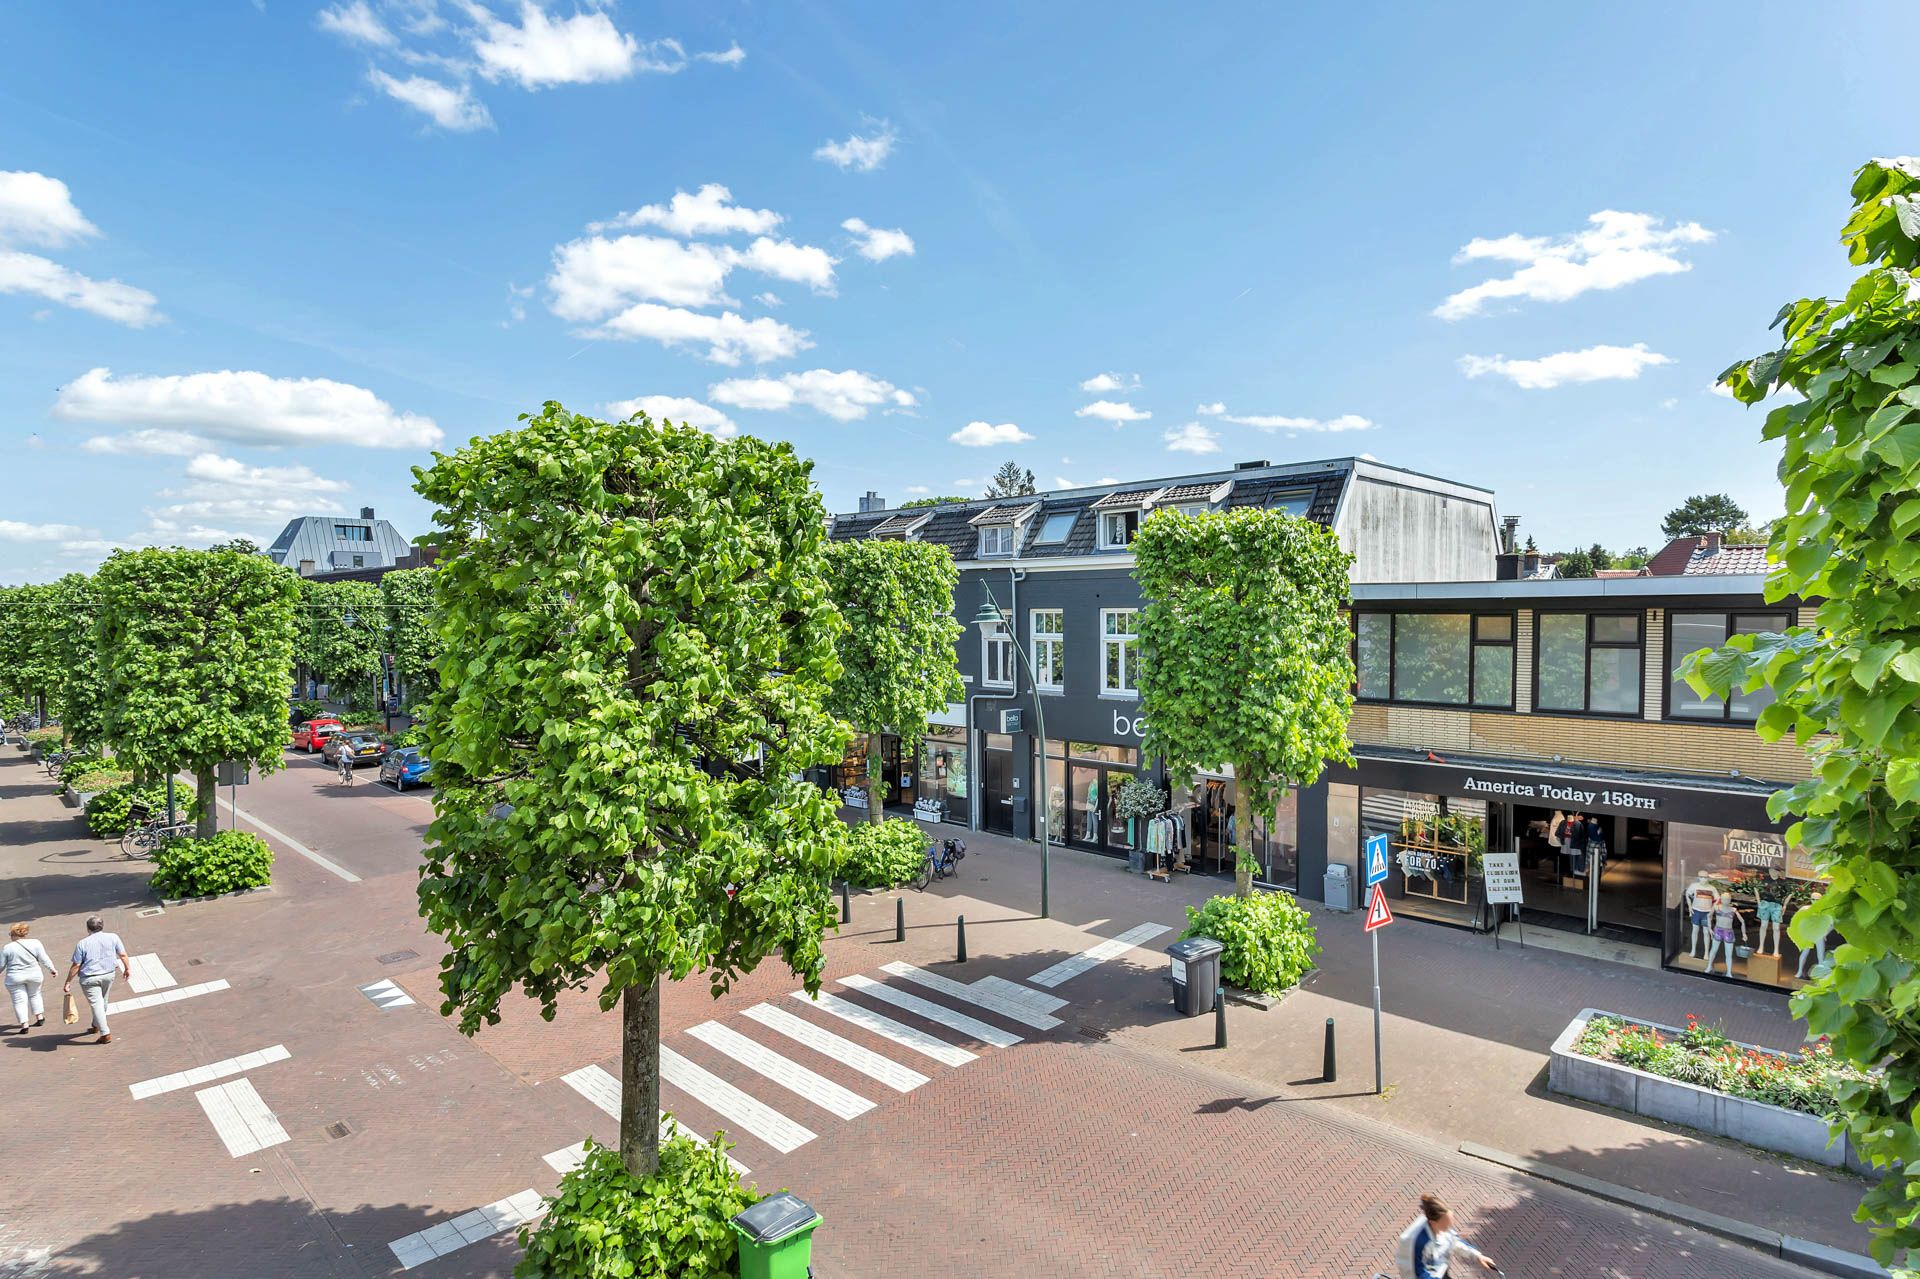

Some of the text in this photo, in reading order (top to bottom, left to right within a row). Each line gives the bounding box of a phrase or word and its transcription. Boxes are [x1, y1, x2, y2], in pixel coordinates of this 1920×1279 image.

[1463, 776, 1656, 810] America Today 158TH
[1411, 811, 1434, 822] TODAY
[1731, 840, 1781, 857] AMERICA
[1740, 852, 1773, 867] TODAY
